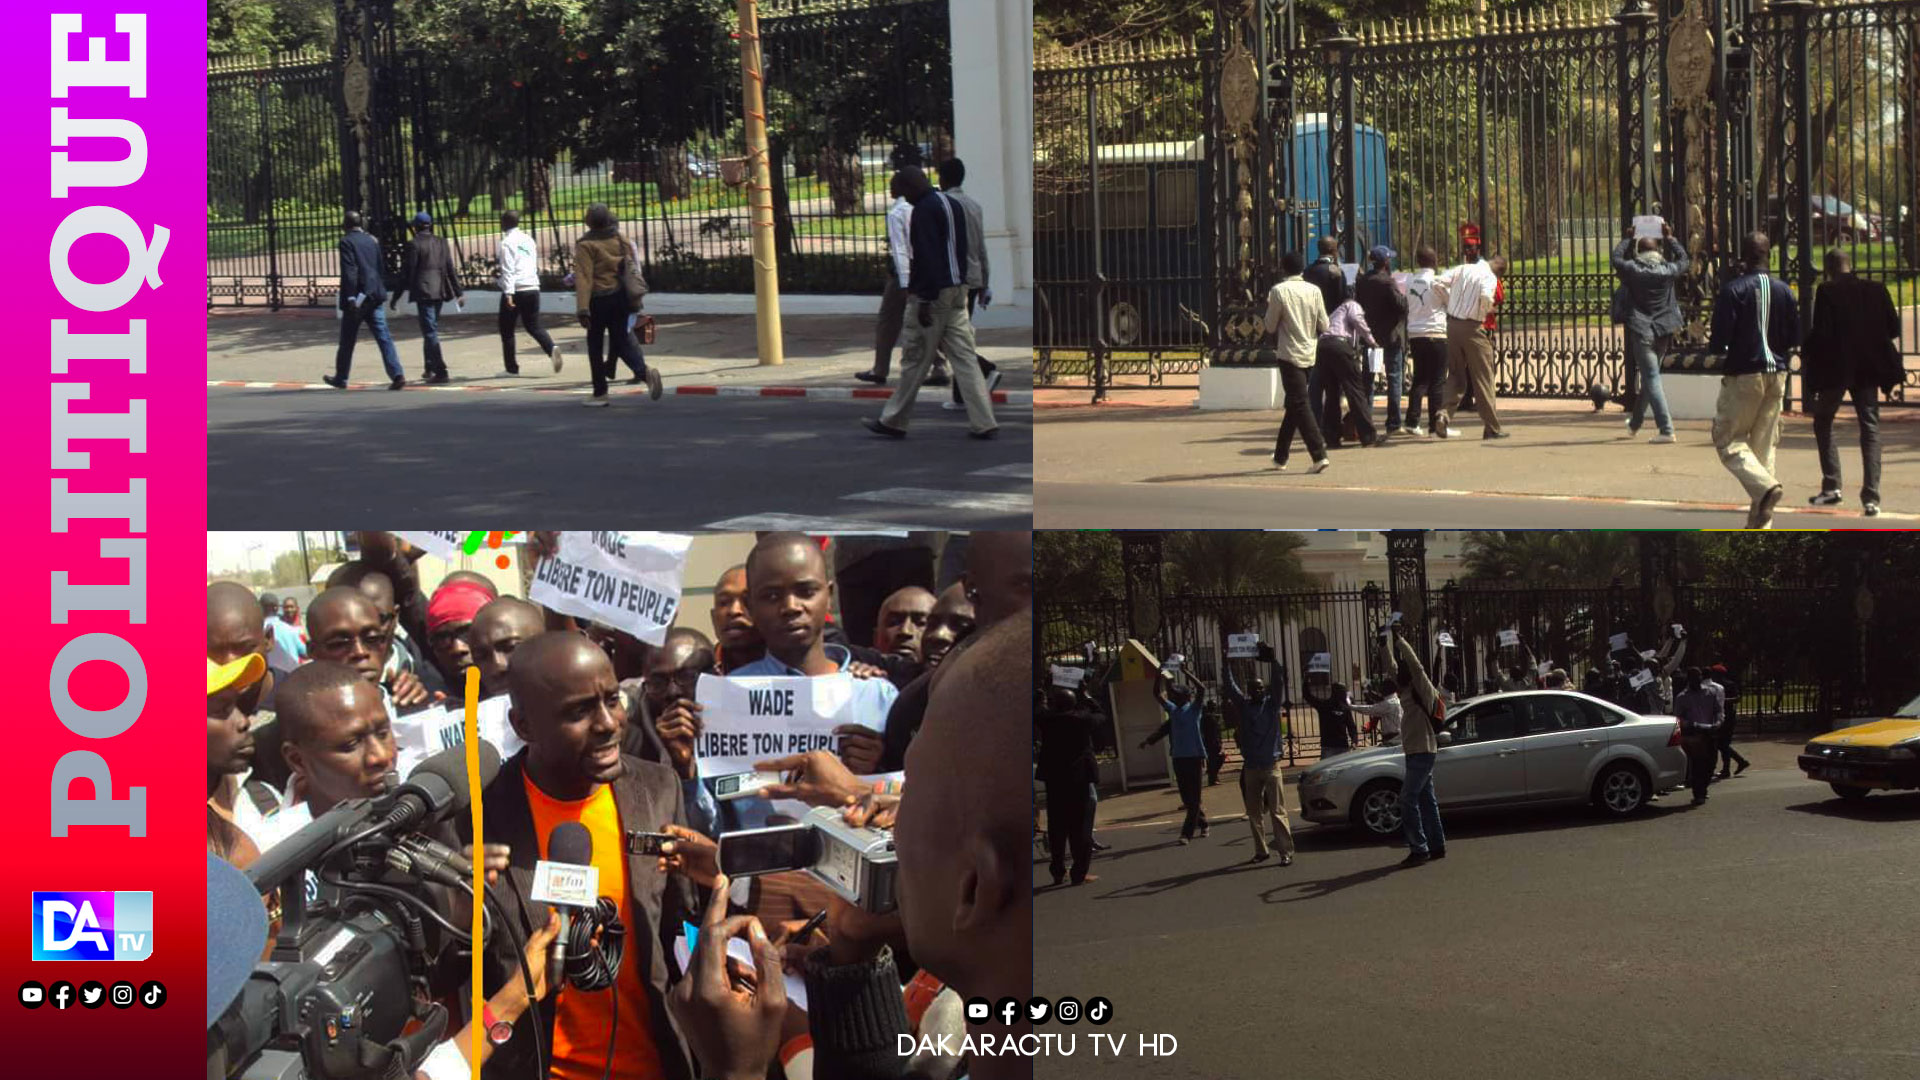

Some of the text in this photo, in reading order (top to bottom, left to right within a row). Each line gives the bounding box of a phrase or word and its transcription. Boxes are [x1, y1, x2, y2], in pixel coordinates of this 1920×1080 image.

[584, 570, 616, 605] TON
[618, 581, 675, 625] PEUPLE
[749, 690, 794, 716] WADE
[697, 733, 748, 758] LIBERE
[753, 734, 783, 754] TON
